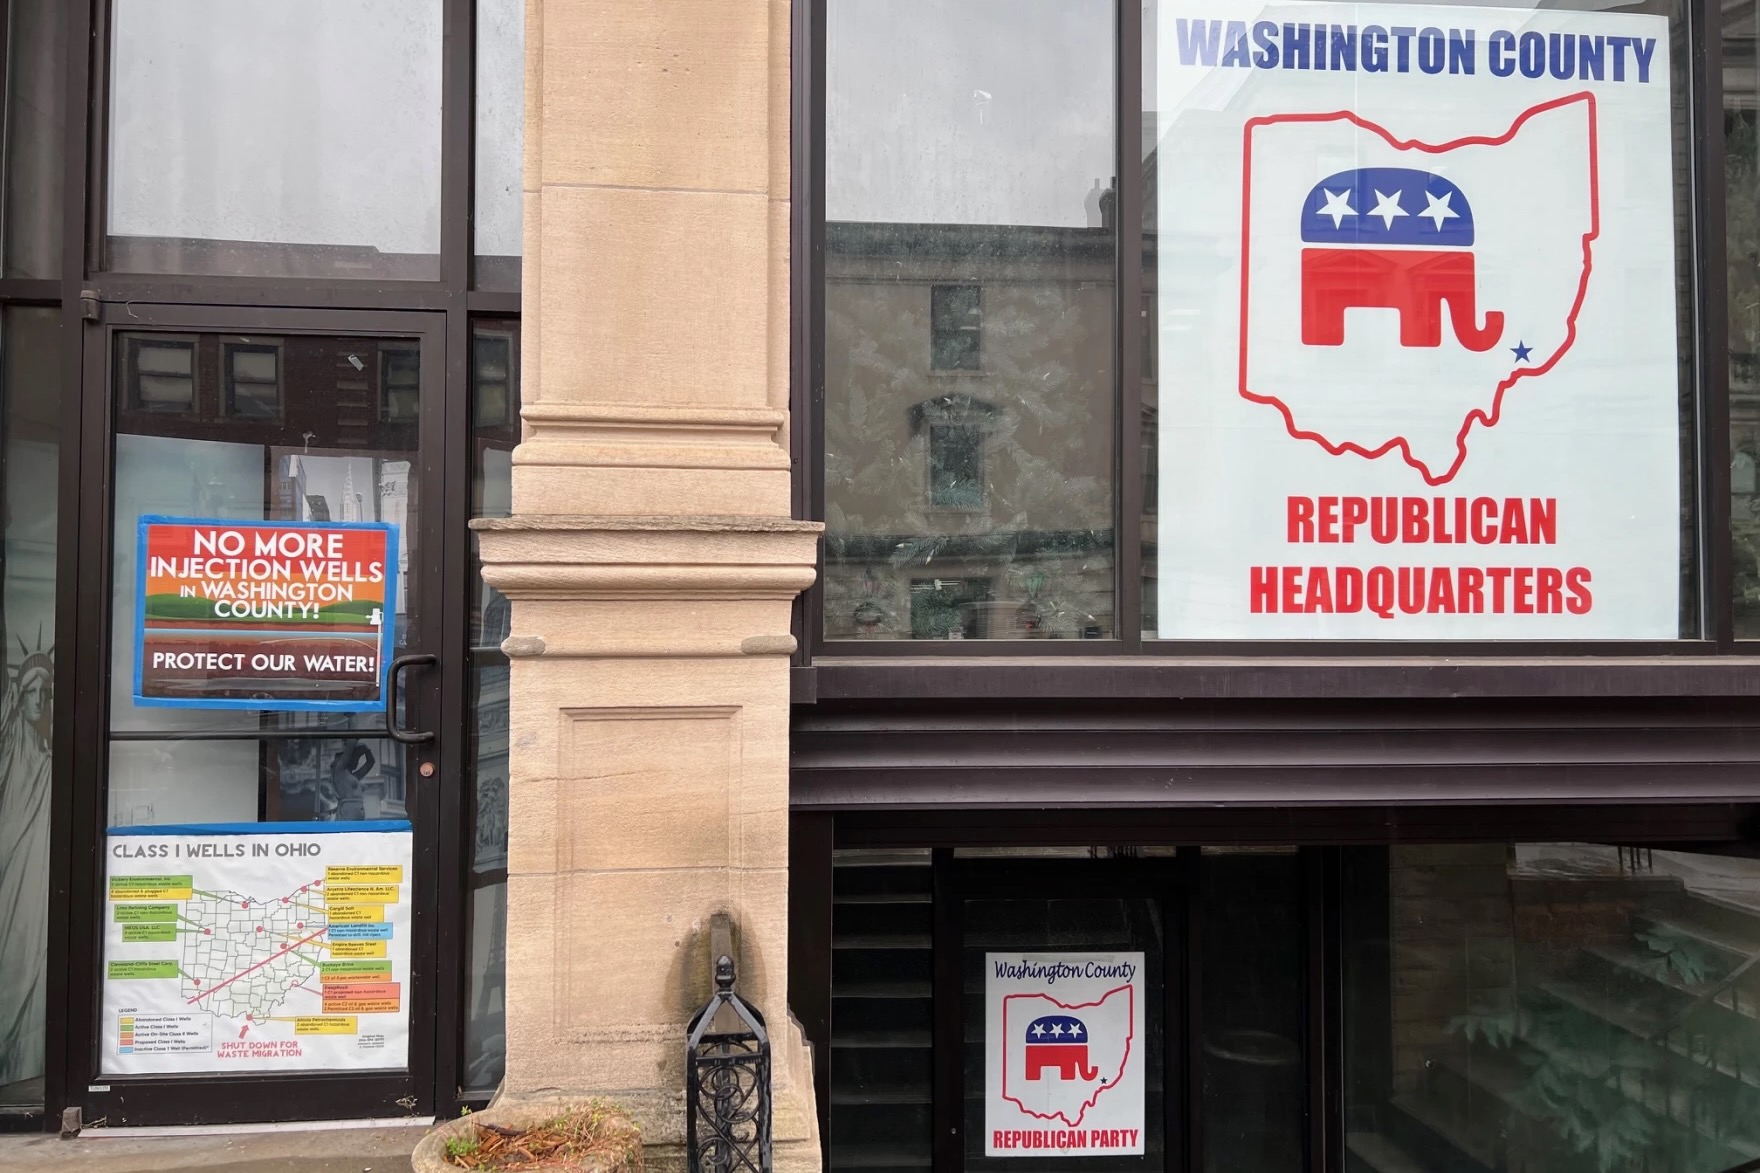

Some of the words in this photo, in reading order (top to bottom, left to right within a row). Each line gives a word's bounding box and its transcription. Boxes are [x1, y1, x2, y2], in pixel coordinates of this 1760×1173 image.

[1176, 18, 1476, 75] WASHINGTON
[1488, 30, 1656, 83] COUNTY
[1287, 496, 1557, 545] REPUBLICAN
[194, 529, 245, 556] NO
[255, 531, 344, 558] MORE
[151, 557, 291, 581] INJECTION
[299, 561, 383, 583] WELLS
[180, 585, 196, 598] IN
[201, 580, 352, 602] WASHINGTON
[1250, 566, 1593, 619] HEADQUARTERS
[215, 601, 320, 619] COUNTY!
[153, 652, 245, 671] PROTECT
[251, 655, 295, 671] OUR
[304, 655, 374, 672] WATER!
[113, 844, 169, 858] CLASS
[176, 844, 179, 857] I
[187, 844, 245, 857] WELLS
[252, 844, 268, 857] IN
[275, 843, 321, 857] OHIO
[995, 960, 1084, 984] Washington
[1085, 961, 1136, 983] County
[217, 1050, 249, 1058] WASTE
[252, 1049, 302, 1057] MIGRATION
[249, 1041, 277, 1049] DOWN
[993, 1130, 1086, 1148] REPUBLICAN
[1091, 1129, 1138, 1147] PARTY
